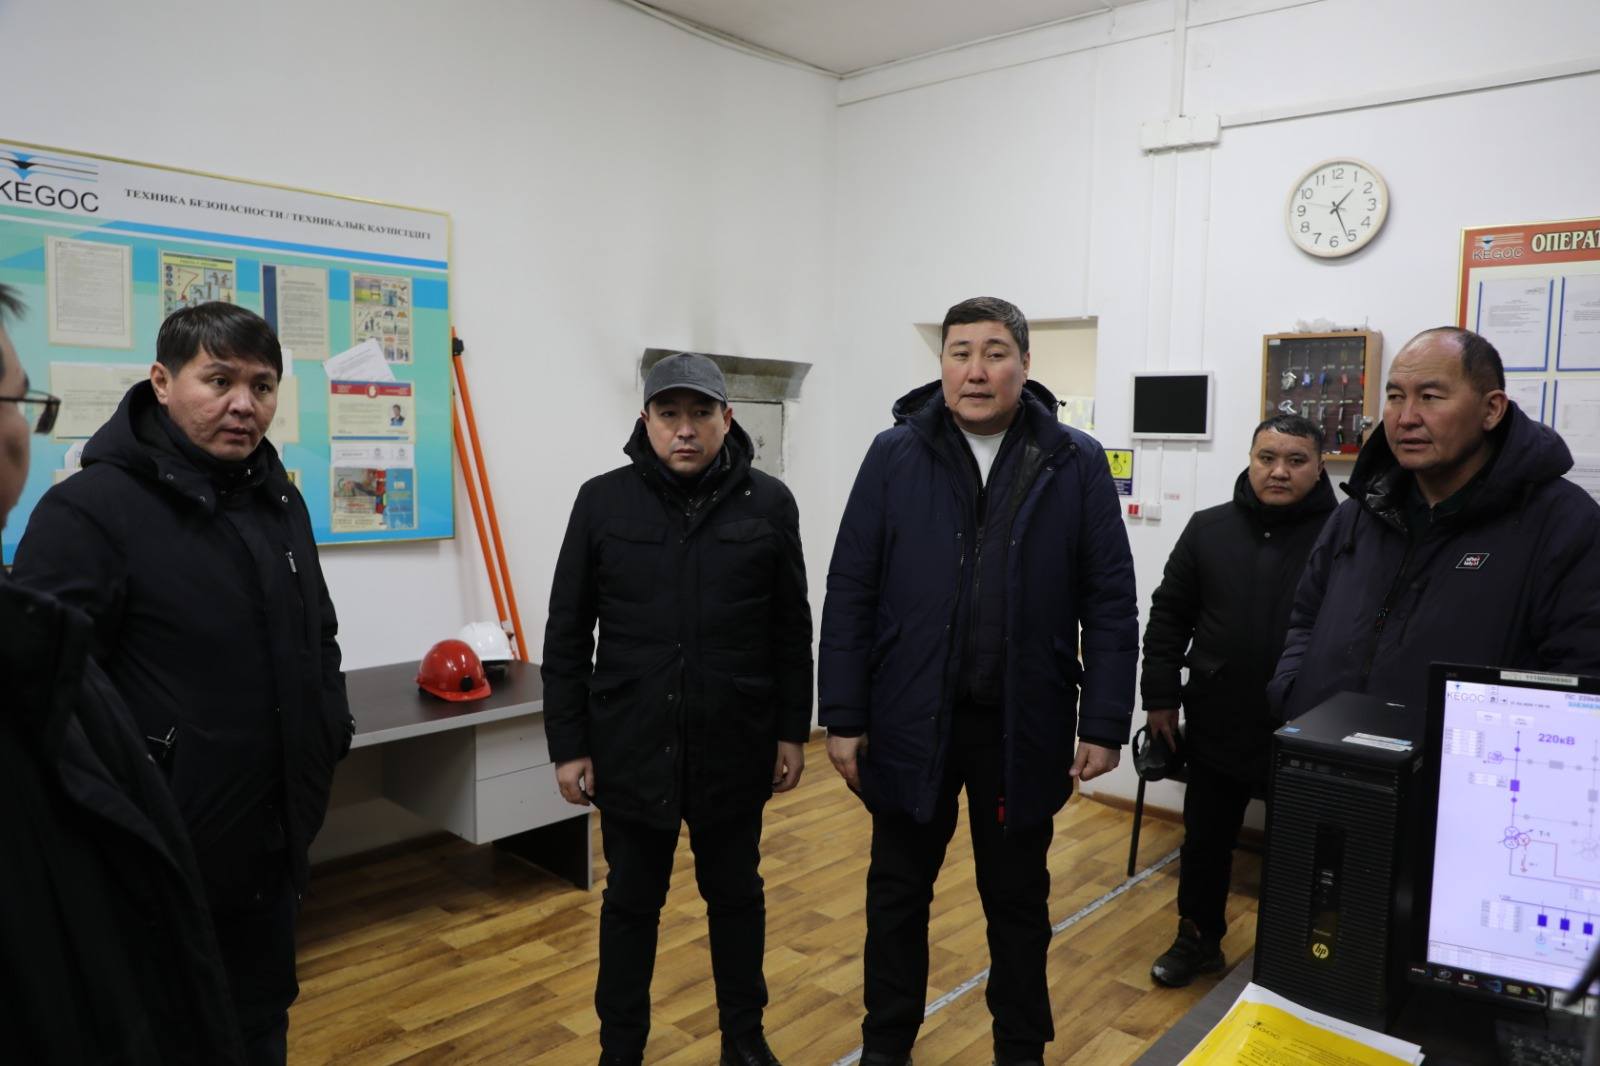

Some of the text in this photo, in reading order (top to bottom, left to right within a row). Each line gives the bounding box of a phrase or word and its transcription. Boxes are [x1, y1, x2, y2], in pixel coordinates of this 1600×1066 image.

[1316, 174, 1325, 186] 11
[1332, 168, 1344, 180] 12
[1354, 170, 1358, 183] 1
[1363, 181, 1373, 194] 2
[1301, 188, 1313, 200] 10
[125, 188, 185, 206] ТЕХНИКА
[189, 197, 283, 219] БЕЗОПАСНОСТИ
[1367, 198, 1377, 211] 3
[1297, 205, 1306, 217] 9
[1300, 221, 1310, 233] 8
[1360, 216, 1371, 228] 4
[1313, 232, 1322, 244] 7
[1329, 235, 1339, 248] 6
[1347, 229, 1357, 242] 5
[1314, 943, 1327, 958] hp
